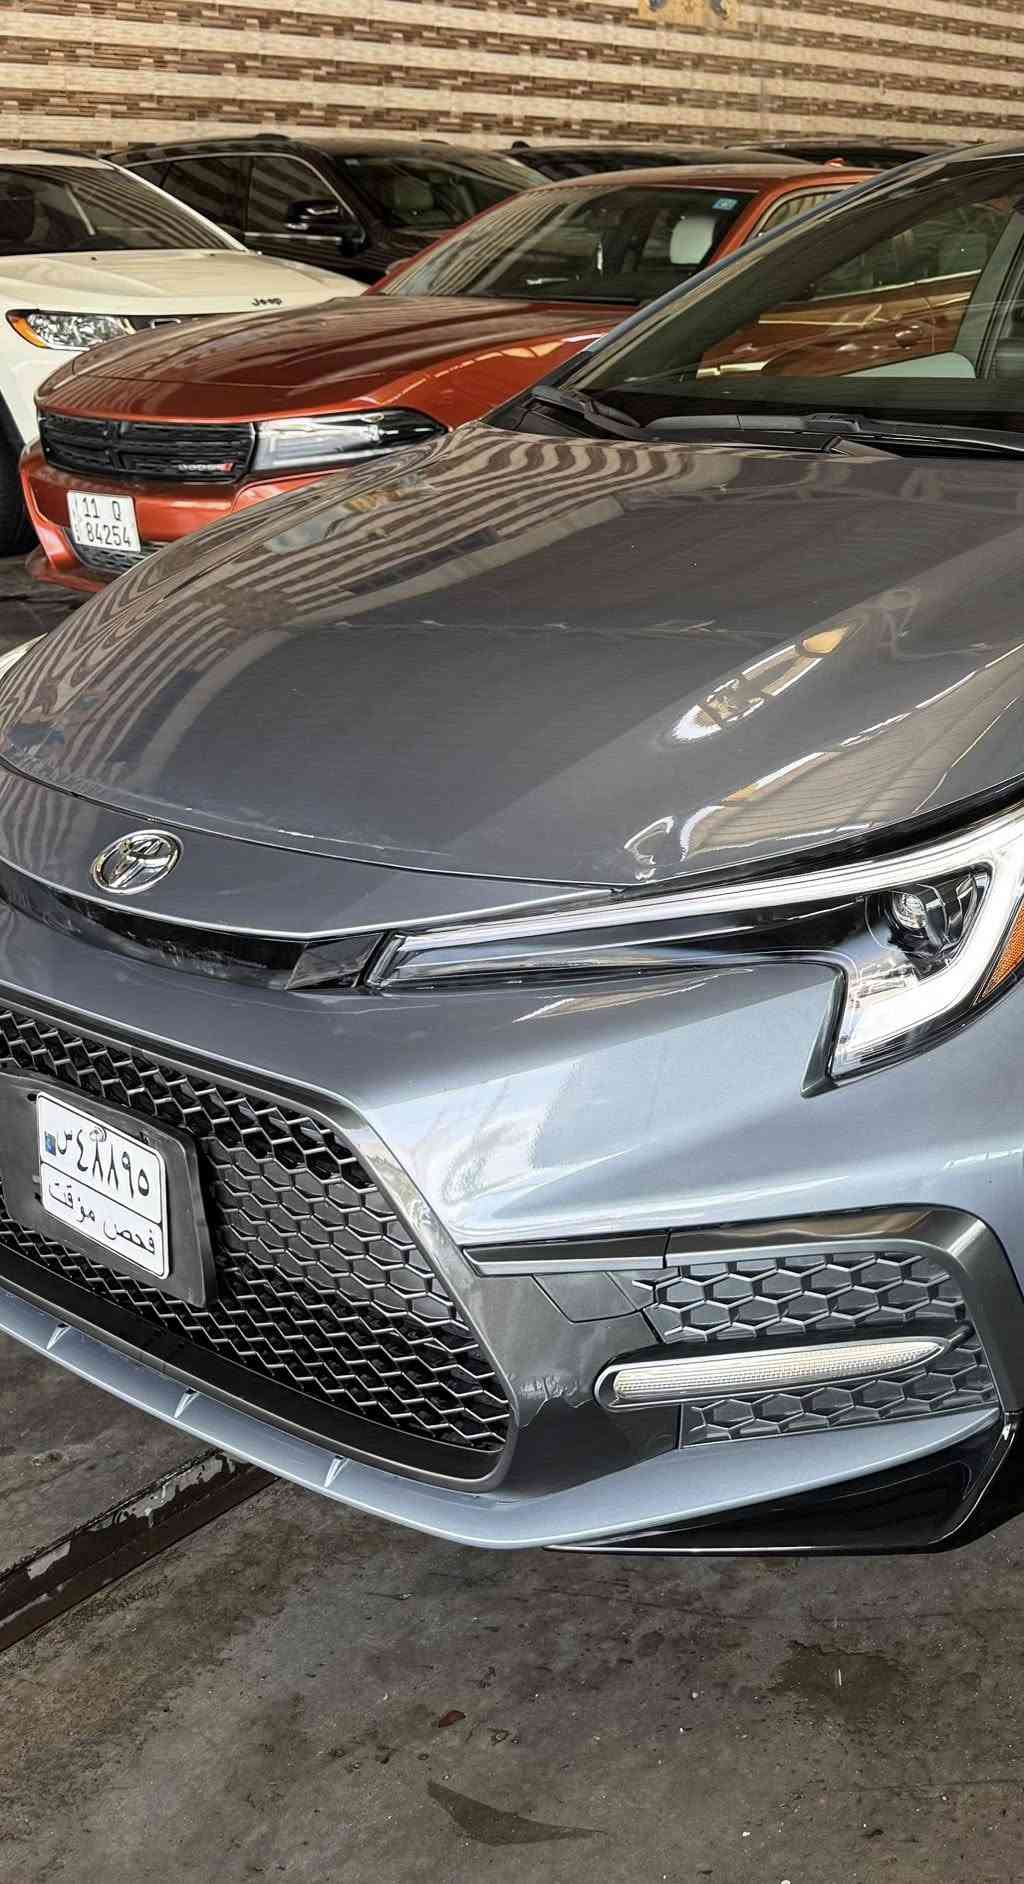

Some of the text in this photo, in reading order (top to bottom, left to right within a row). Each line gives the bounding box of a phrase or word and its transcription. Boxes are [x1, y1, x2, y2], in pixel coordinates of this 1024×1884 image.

[82, 497, 101, 518] 11
[86, 521, 132, 547] 84254
[103, 1219, 156, 1255] فحص
